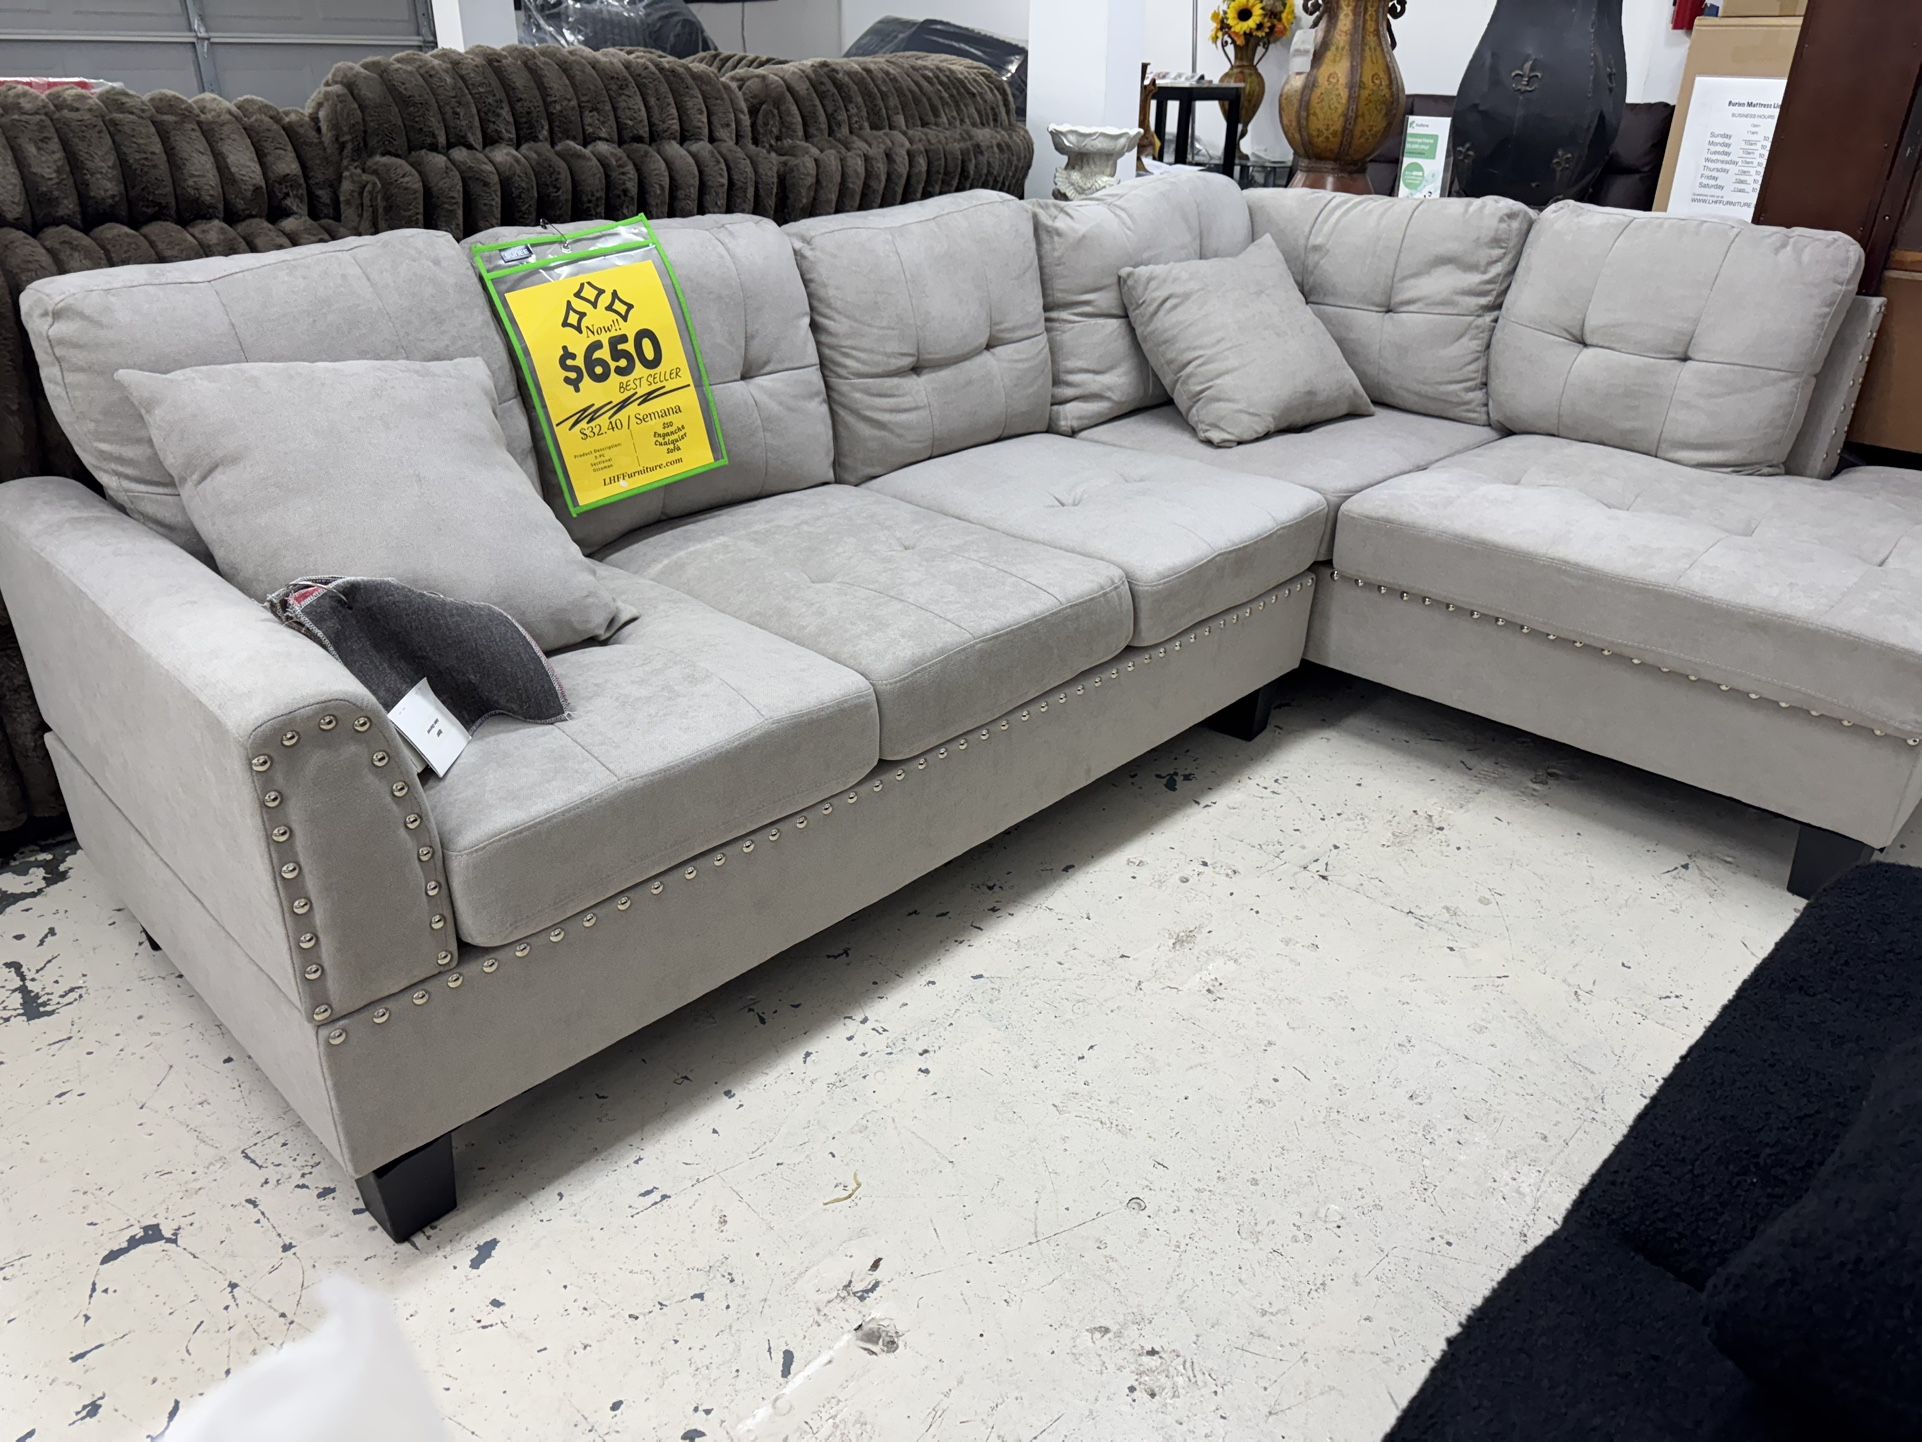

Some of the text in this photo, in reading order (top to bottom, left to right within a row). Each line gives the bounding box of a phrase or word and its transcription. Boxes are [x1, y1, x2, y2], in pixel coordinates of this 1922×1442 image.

[1710, 131, 1732, 140] Sunday
[1708, 140, 1732, 149] Monday
[1706, 149, 1732, 157] Tuesday
[1704, 157, 1739, 167] Wednesday
[1702, 165, 1730, 174] Thursday
[1700, 173, 1719, 182] Friday
[1698, 182, 1725, 191] Saturday
[585, 318, 622, 339] Now!!
[558, 328, 663, 393] $650
[618, 367, 682, 394] BEST SELLER
[580, 418, 624, 441] $32.40
[635, 405, 682, 426] Semana
[654, 424, 686, 440] Enganche
[654, 432, 687, 446] Cualquier
[574, 450, 593, 459] Product
[590, 458, 612, 467] Sectional
[592, 464, 613, 472] Ottoman
[603, 457, 683, 487] LHFFurniture.com
